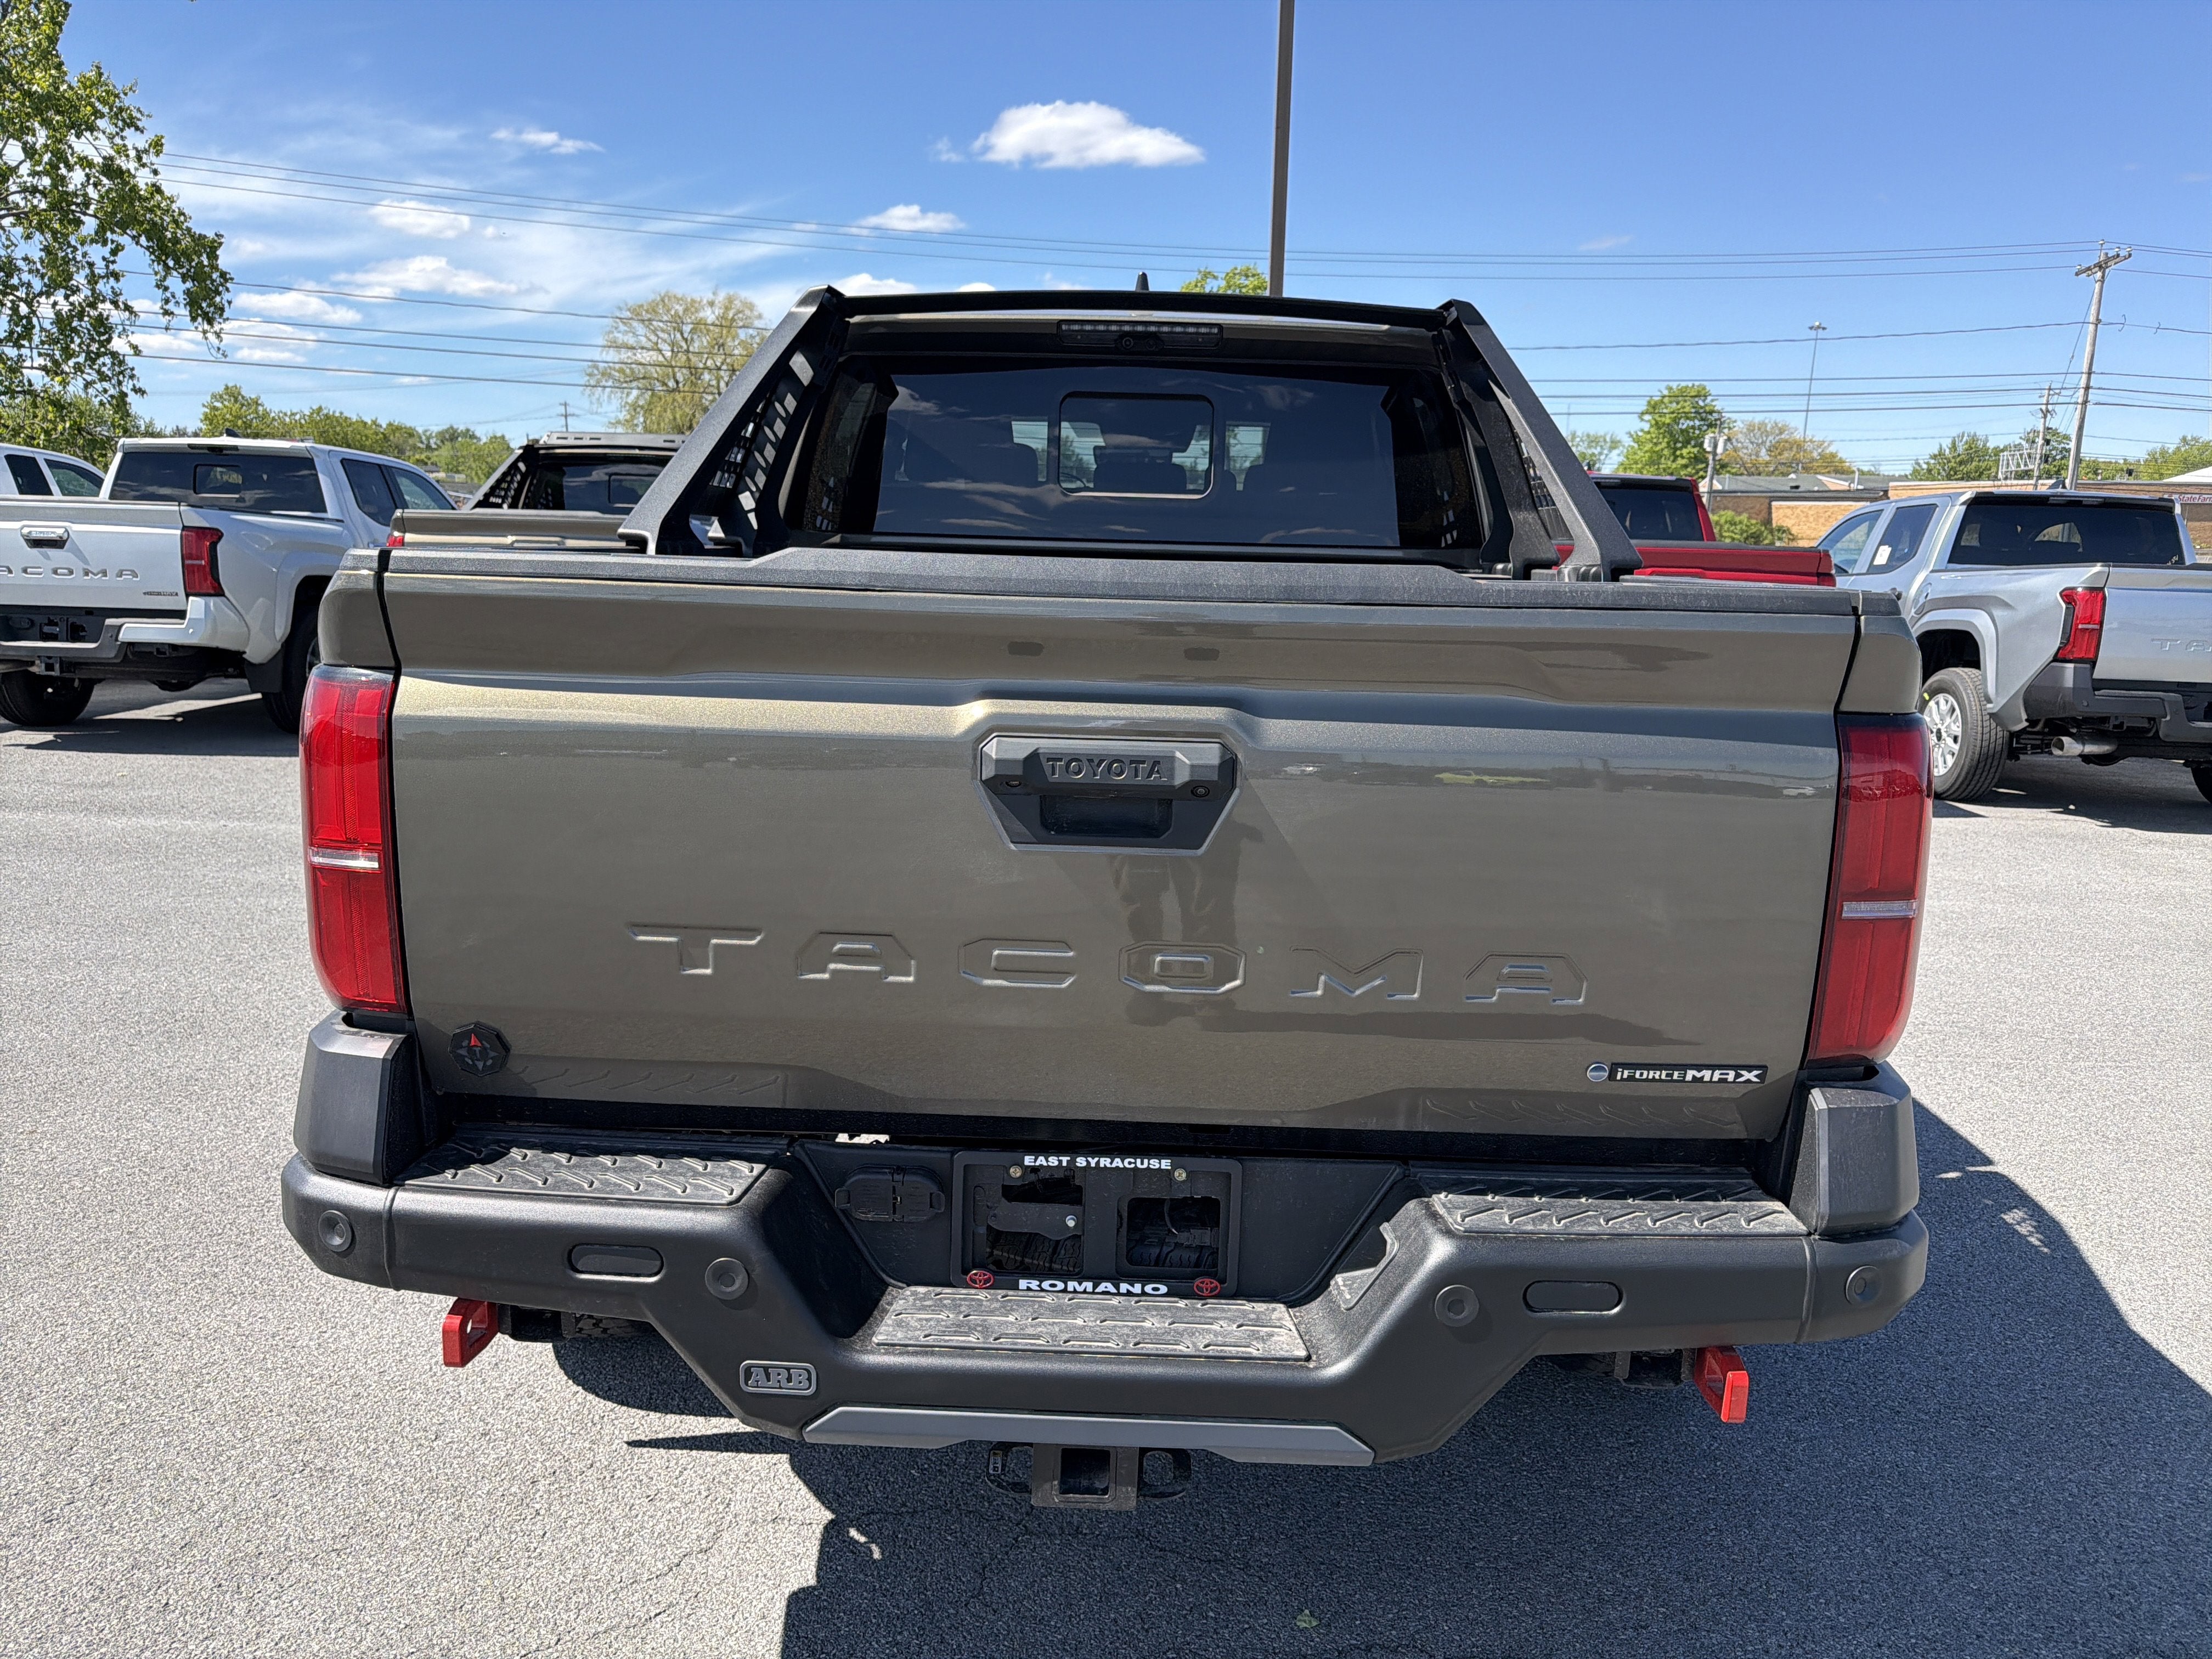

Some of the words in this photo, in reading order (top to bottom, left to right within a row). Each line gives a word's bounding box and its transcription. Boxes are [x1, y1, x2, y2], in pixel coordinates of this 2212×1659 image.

[1046, 757, 1168, 781] TOYOTA
[625, 923, 1589, 1006] TACOMA
[1024, 1155, 1070, 1166] EAST
[1076, 1156, 1171, 1170] SYRACUSE
[1019, 1279, 1169, 1294] ROMANO
[748, 1367, 810, 1389] ARB
